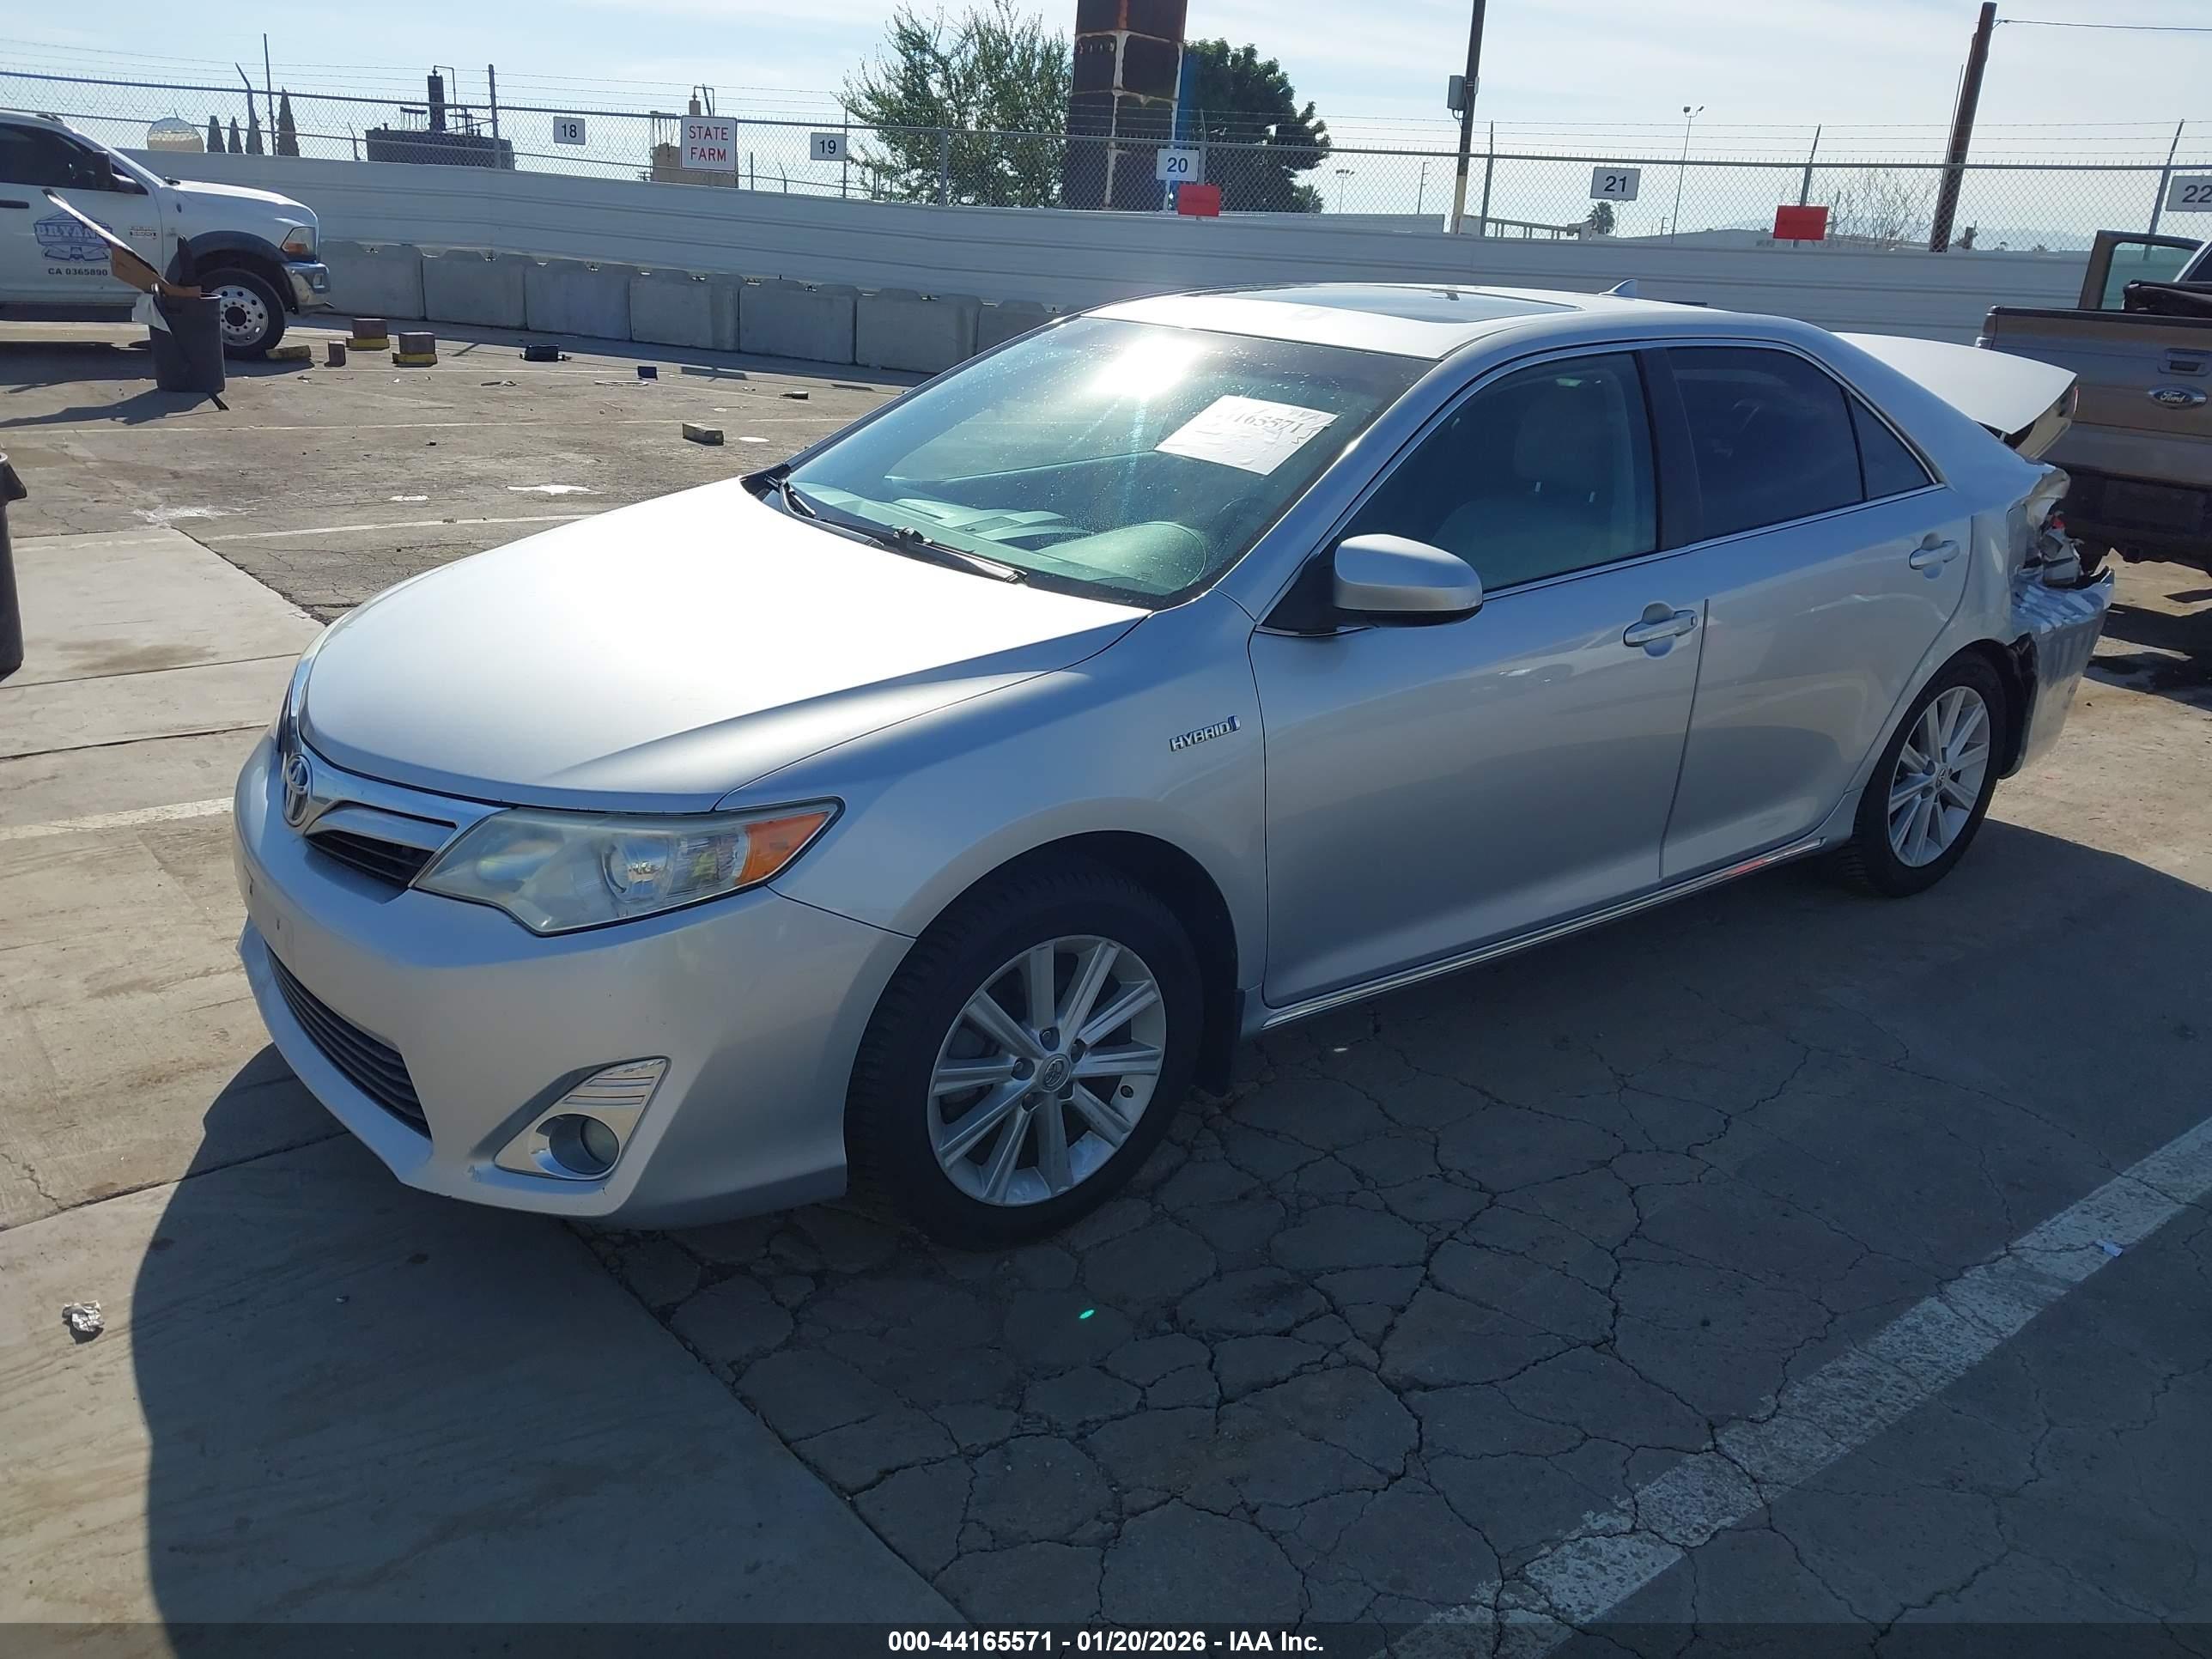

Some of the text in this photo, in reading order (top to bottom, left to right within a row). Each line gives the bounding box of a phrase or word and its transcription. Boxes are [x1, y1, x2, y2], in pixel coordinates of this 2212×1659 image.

[561, 123, 577, 138] 18
[689, 125, 729, 141] STATE
[690, 146, 726, 162] FARM
[819, 139, 836, 155] 19
[1166, 156, 1188, 173] 20
[1603, 175, 1626, 193] 21
[2182, 185, 2212, 204] 22
[48, 267, 63, 276] CA
[2160, 391, 2186, 404] Ford
[1170, 720, 1231, 752] HYBRID
